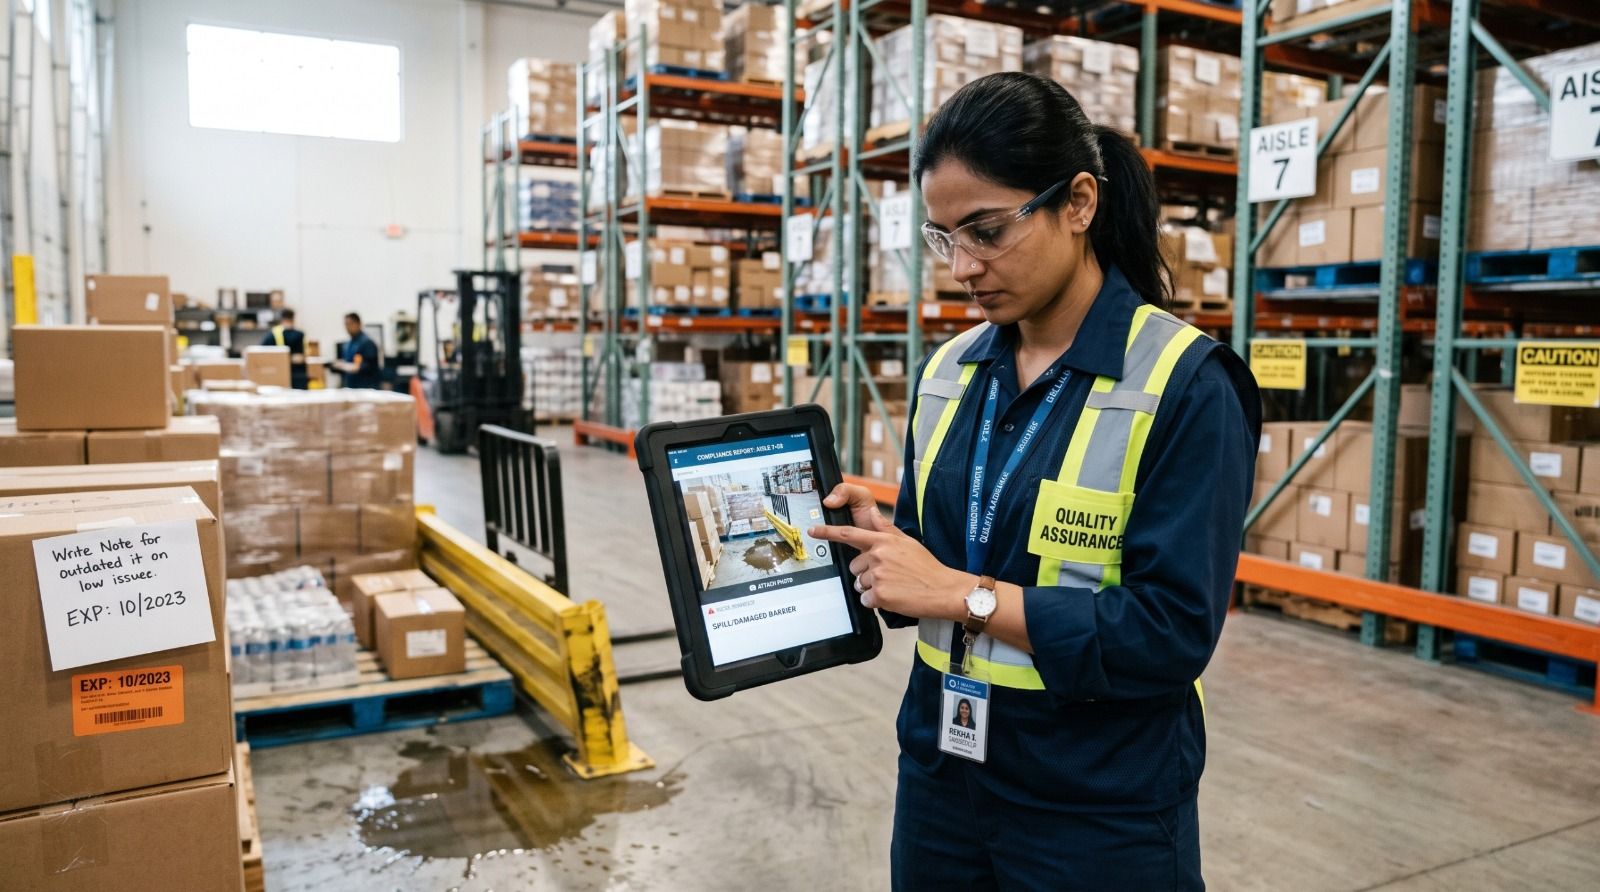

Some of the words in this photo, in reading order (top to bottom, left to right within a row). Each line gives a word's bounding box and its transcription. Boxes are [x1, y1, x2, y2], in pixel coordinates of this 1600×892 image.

[1256, 126, 1309, 155] AISLE
[1273, 157, 1290, 190] 7
[1522, 348, 1598, 366] CAUTION
[697, 450, 732, 461] COMPLIANCE
[1056, 507, 1117, 531] QUALITY
[52, 546, 93, 562] Write
[100, 538, 133, 552] Note
[140, 532, 161, 546] for
[1040, 525, 1124, 550] ASSURANCE
[60, 556, 123, 579] outdated
[130, 553, 142, 565] it
[151, 551, 168, 561] on
[79, 579, 104, 592] low
[757, 580, 777, 590] ATTACH
[777, 577, 794, 585] PHOTO
[67, 605, 111, 627] EXP:
[712, 612, 768, 630] SPILL/DAMAGED
[768, 605, 797, 617] BARRIER
[80, 677, 112, 692] EXP:
[118, 671, 171, 688] 10/2023
[949, 727, 971, 740] REKHA
